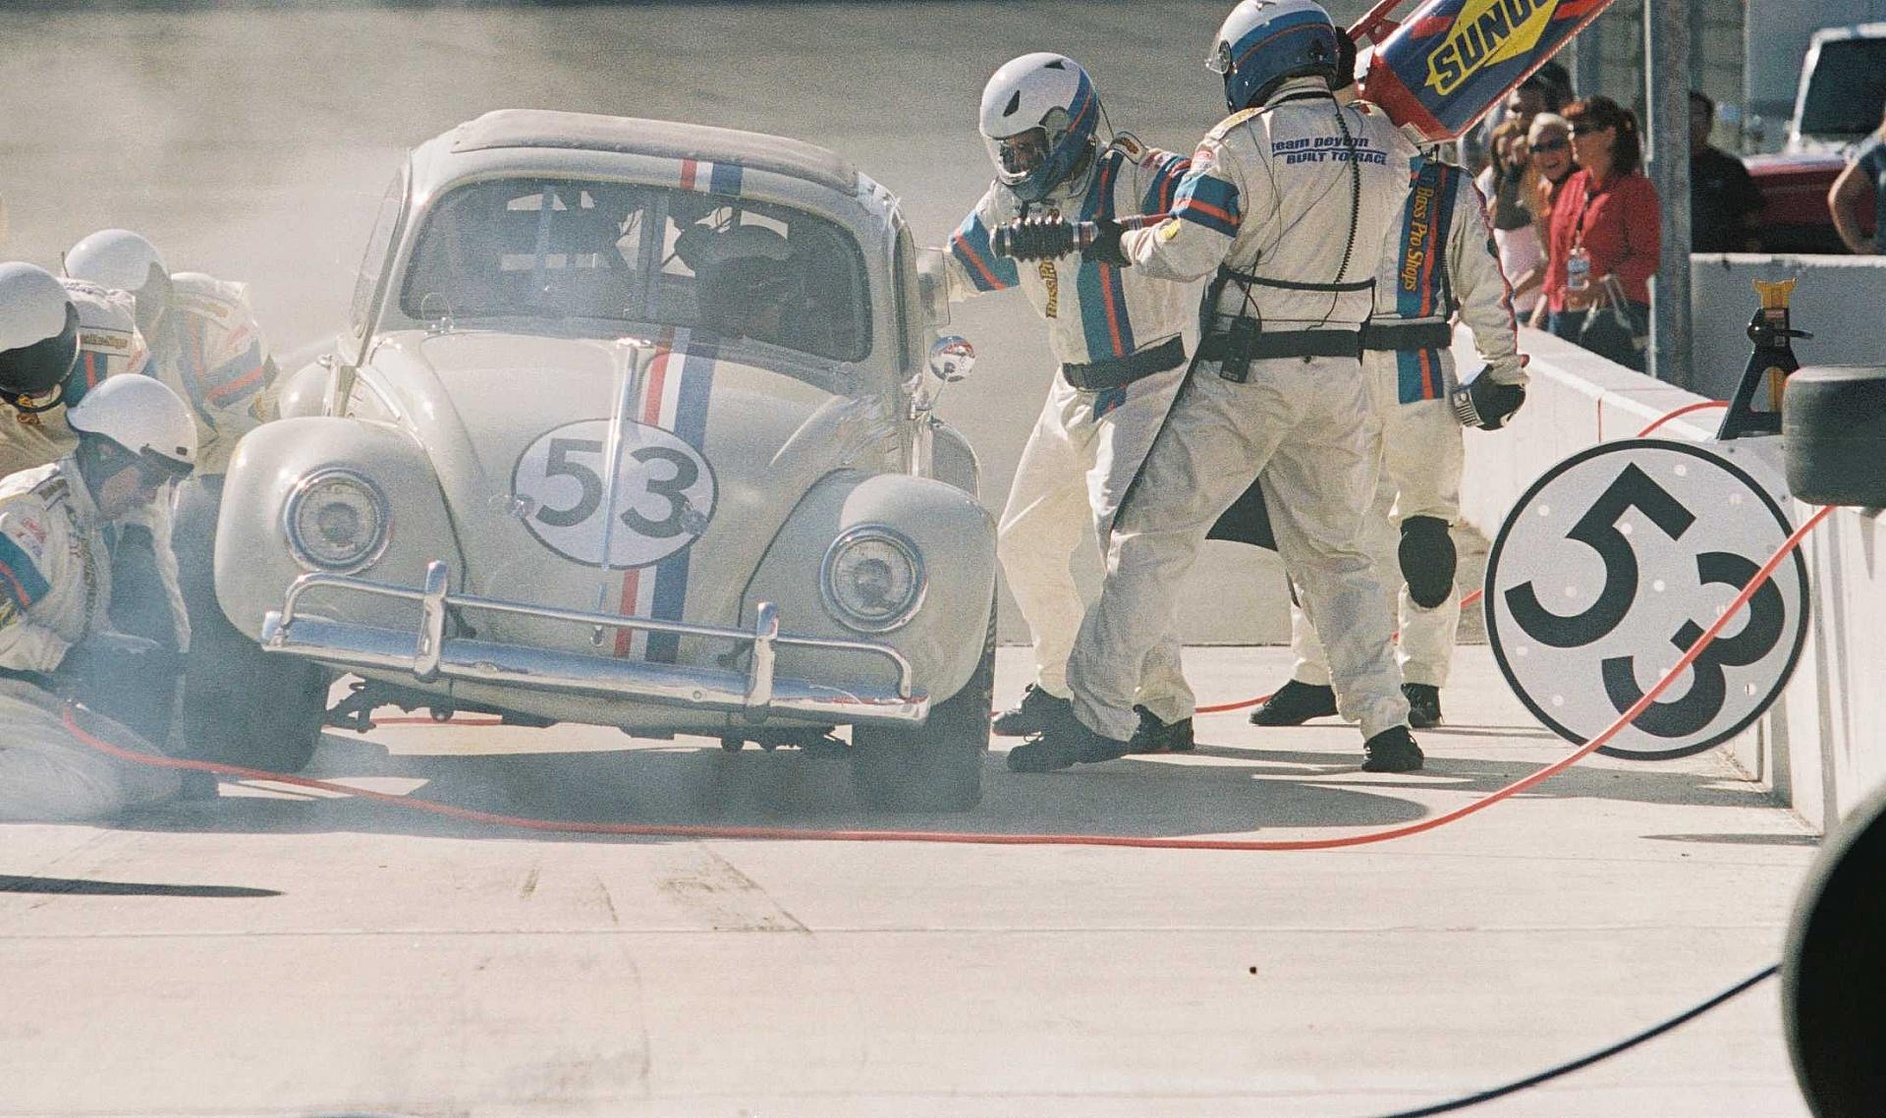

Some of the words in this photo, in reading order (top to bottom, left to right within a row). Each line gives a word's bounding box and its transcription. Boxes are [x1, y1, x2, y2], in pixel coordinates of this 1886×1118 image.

[1433, 0, 1545, 90] SUNO
[1286, 152, 1327, 164] BUILT
[1331, 151, 1350, 161] TO
[1314, 136, 1369, 148] peyon
[1413, 187, 1434, 219] Bass
[1410, 220, 1428, 246] Pro
[1402, 247, 1424, 291] Shops
[534, 437, 699, 539] 53
[1504, 461, 1785, 738] 53
